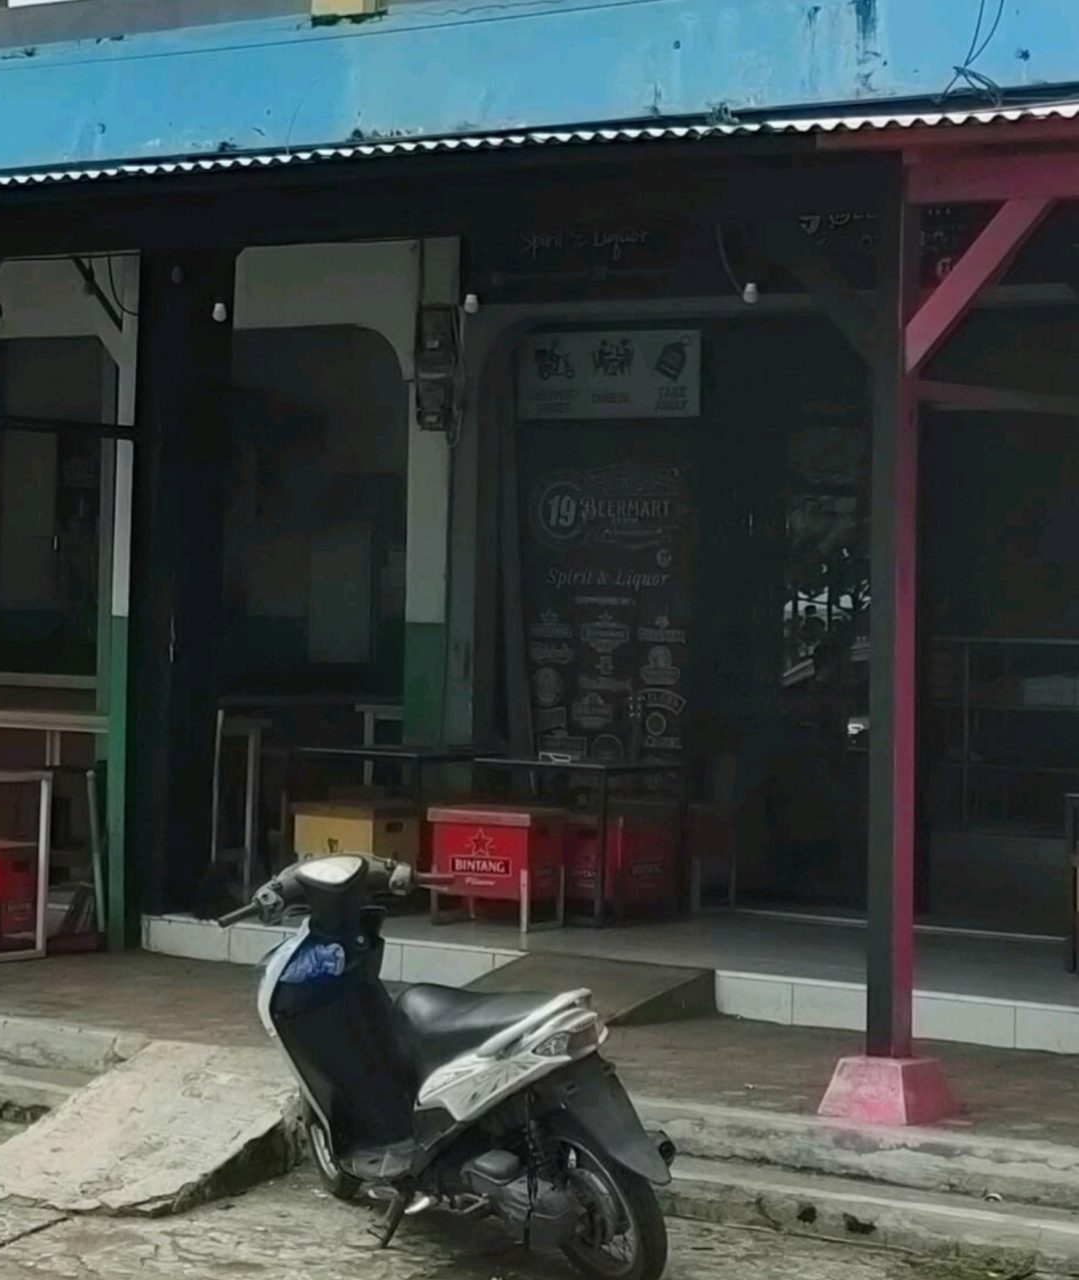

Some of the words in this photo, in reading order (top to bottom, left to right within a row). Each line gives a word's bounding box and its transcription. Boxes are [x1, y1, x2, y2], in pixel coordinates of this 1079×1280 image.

[547, 494, 577, 528] 19
[579, 495, 671, 520] BEERMART
[545, 567, 593, 590] Spirit
[615, 570, 670, 592] Liquor
[453, 858, 506, 874] BINTANG
